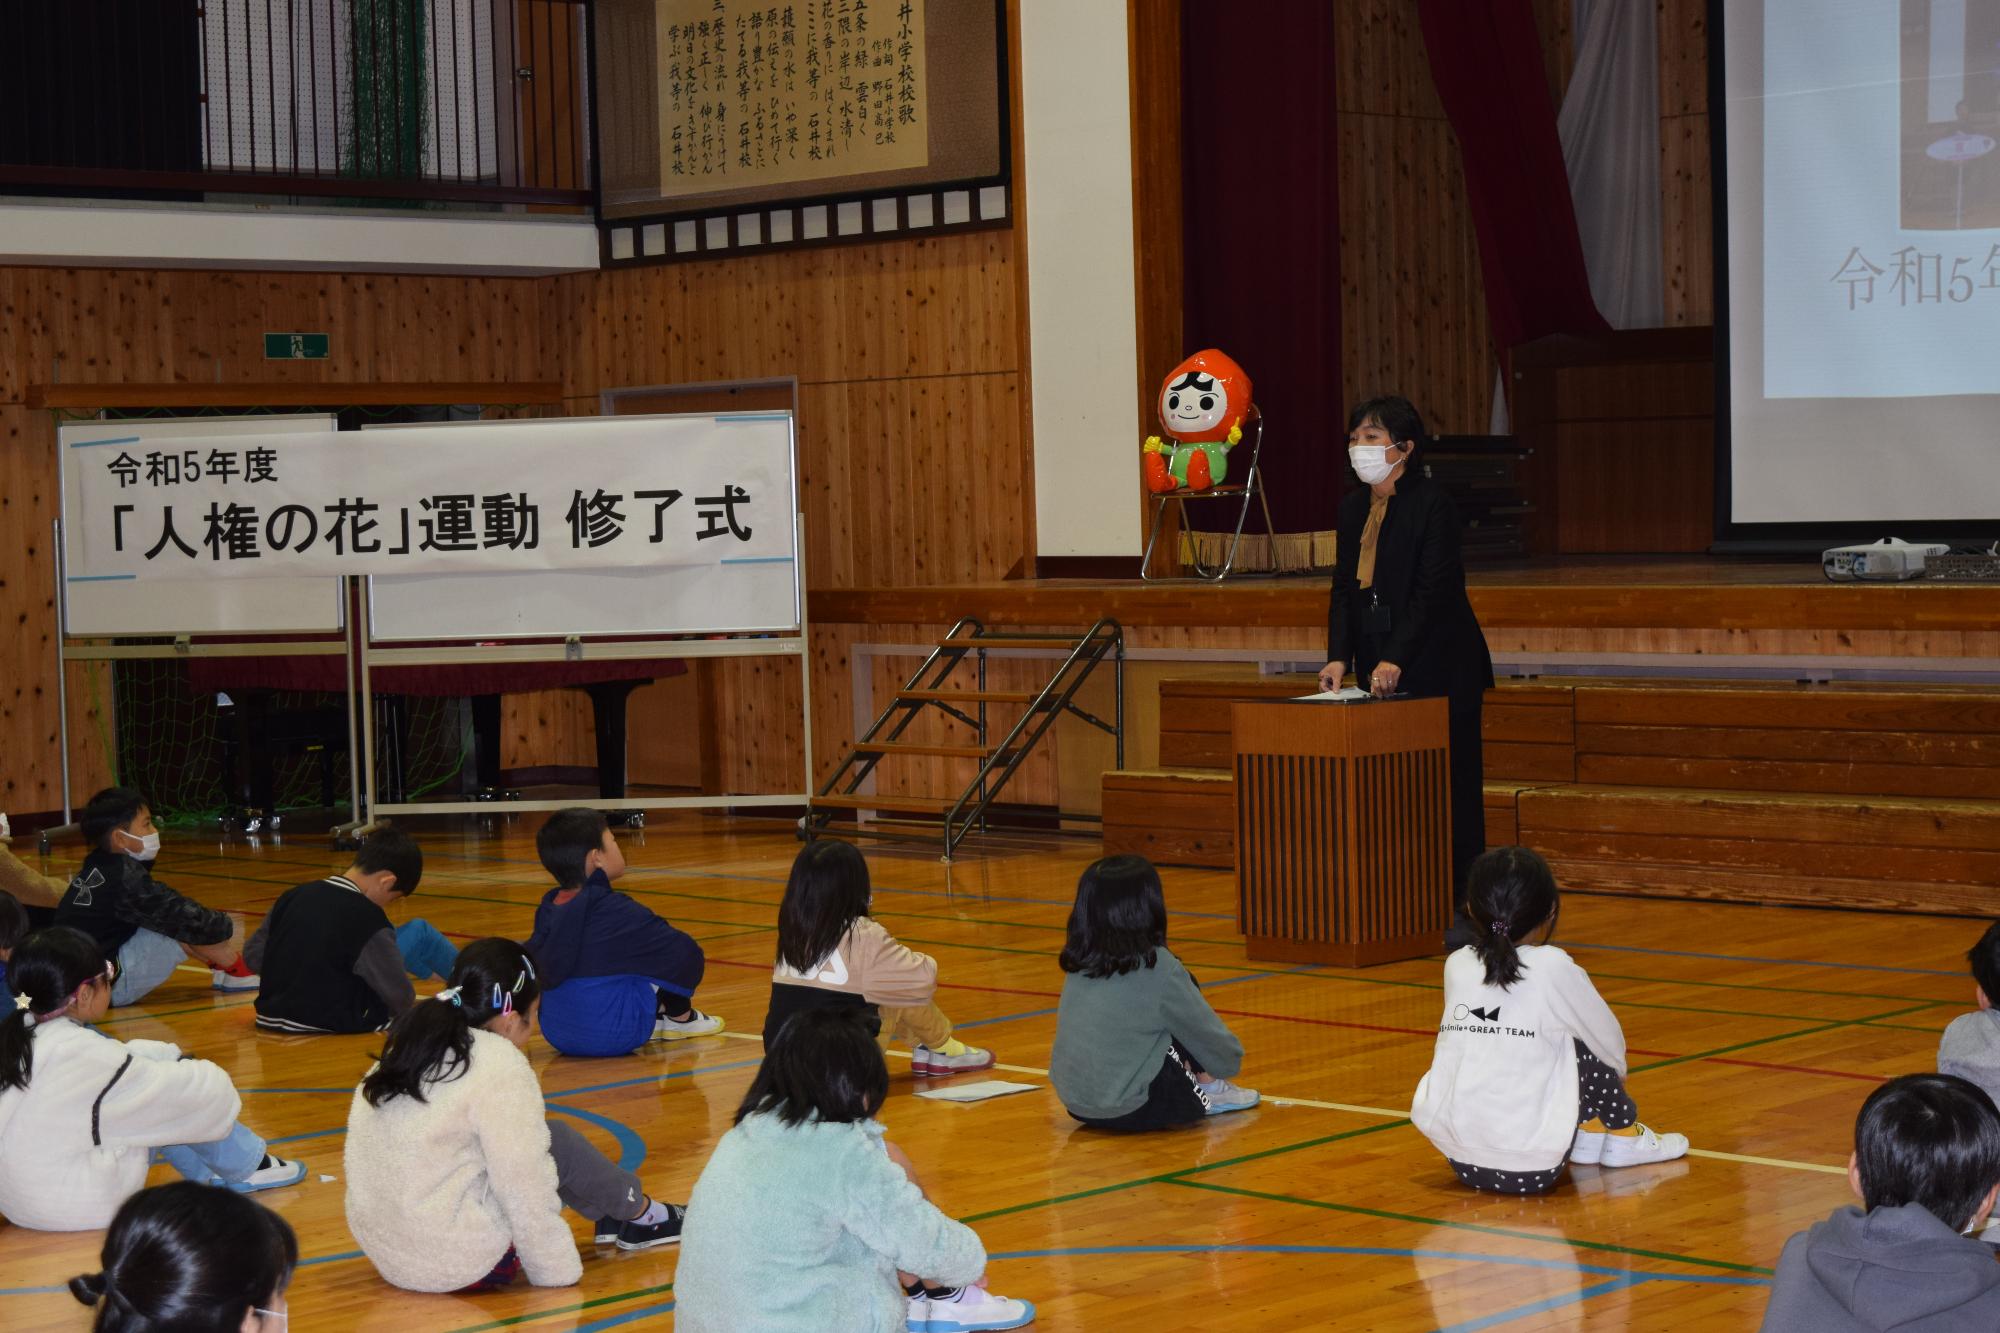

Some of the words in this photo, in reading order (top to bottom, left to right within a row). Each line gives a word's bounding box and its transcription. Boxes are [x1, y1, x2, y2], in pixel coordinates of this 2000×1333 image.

[883, 38, 894, 66] 作詞
[840, 100, 854, 152] 水清し
[855, 81, 869, 136] 雲白く
[883, 78, 896, 144] 石井小学校
[671, 125, 685, 175] 石井校
[738, 121, 752, 168] 石井校
[808, 112, 823, 161] 石井校
[107, 447, 278, 488] 令和5年度
[113, 492, 539, 561] 「人権の花」運動
[565, 485, 753, 549] 修了式
[1469, 1025, 1501, 1034] GREAT
[1505, 1027, 1535, 1038] TEAM
